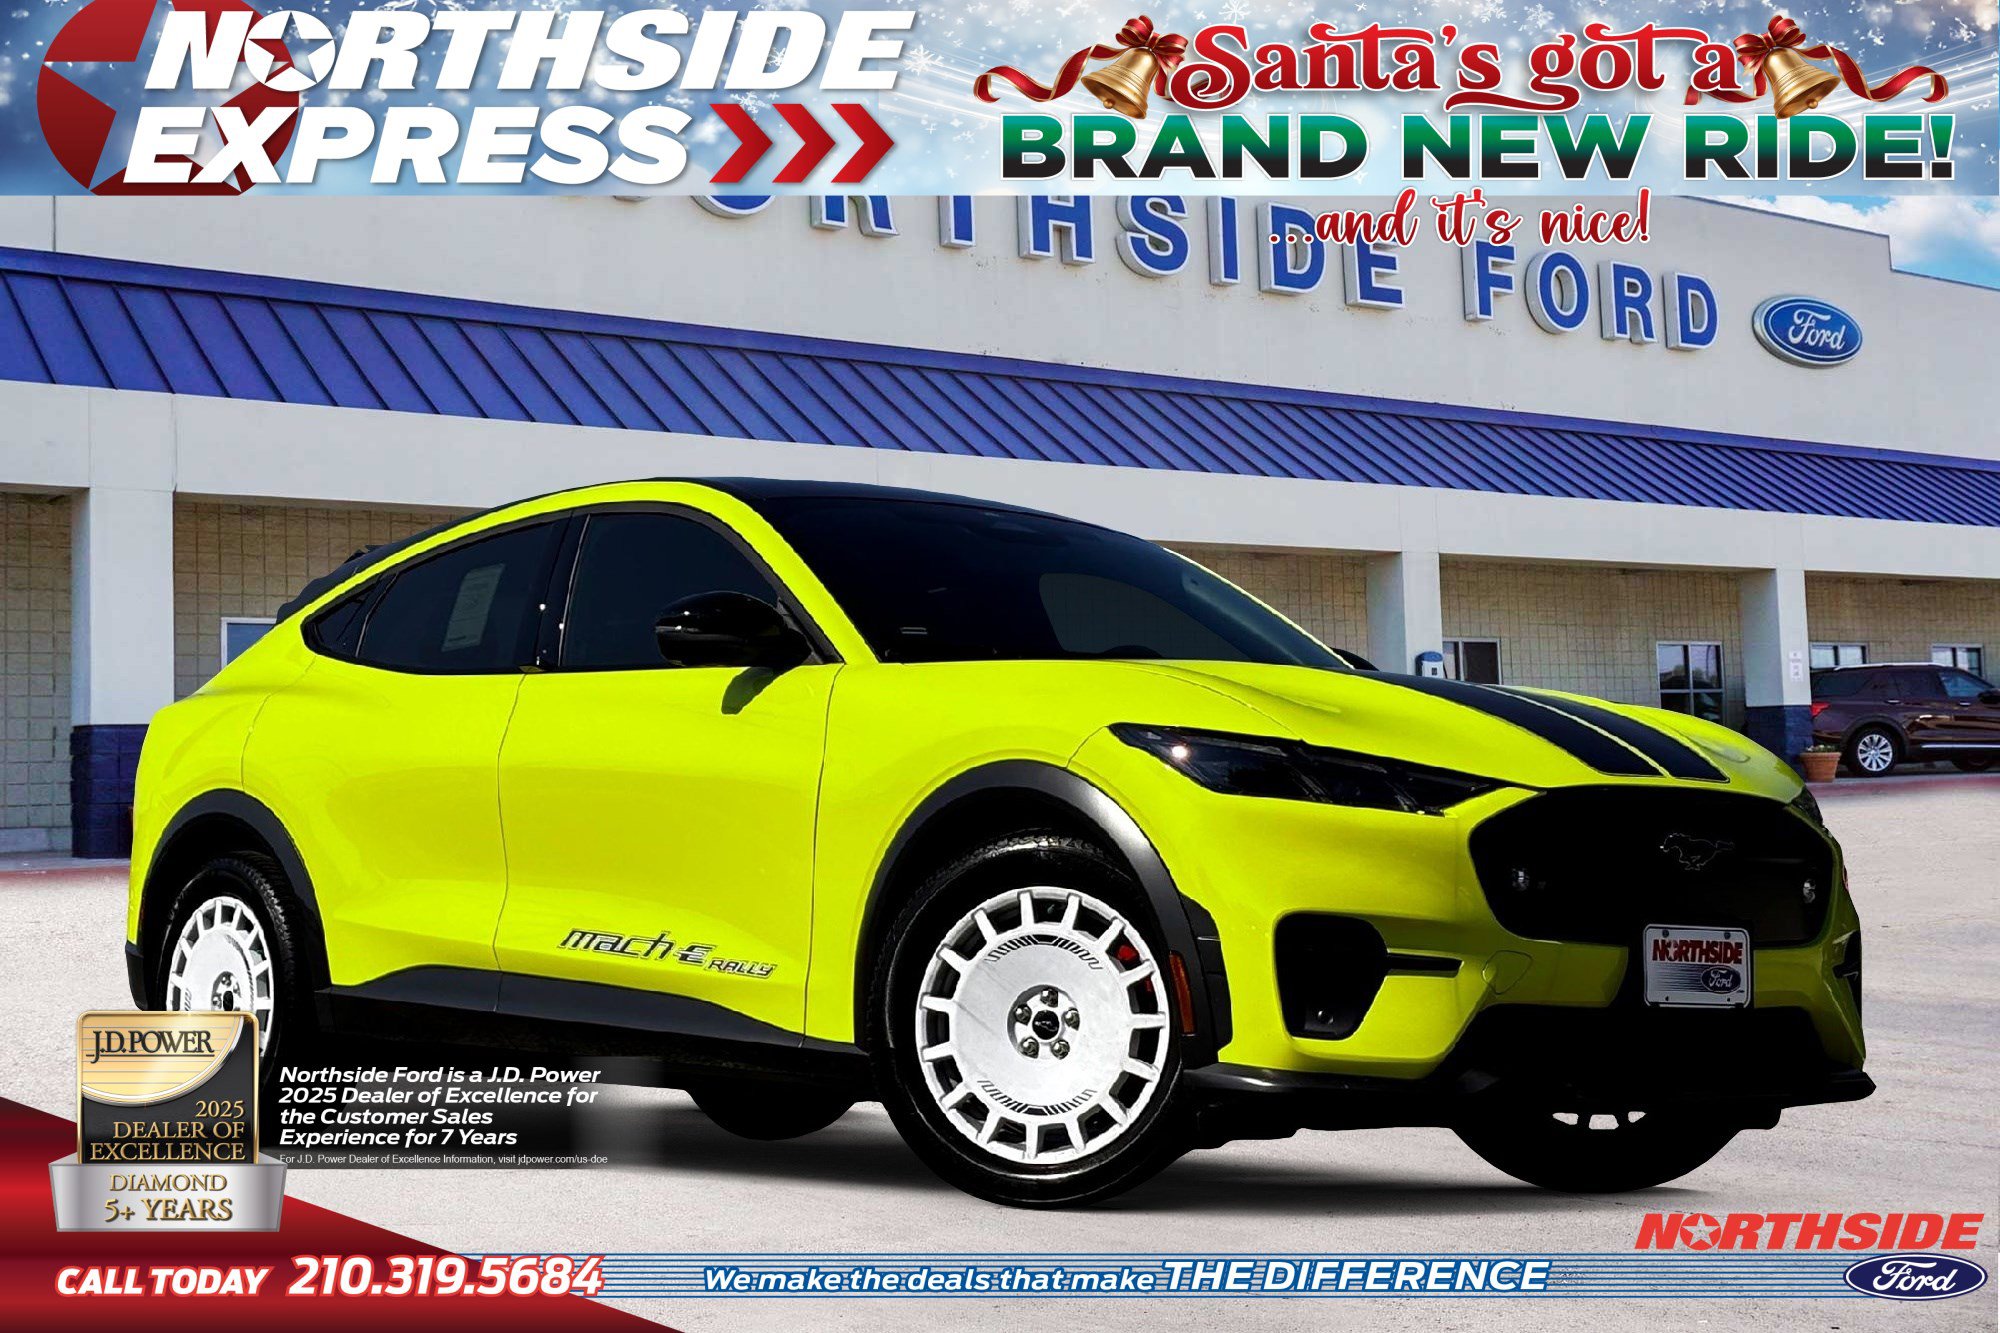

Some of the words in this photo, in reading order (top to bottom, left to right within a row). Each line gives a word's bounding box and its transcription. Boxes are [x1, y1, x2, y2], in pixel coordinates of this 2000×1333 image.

[1464, 239, 1718, 350] FORD
[1787, 310, 1847, 352] Ford
[1652, 939, 1743, 965] NORTHSIDE
[704, 957, 777, 979] RALLY
[1709, 969, 1733, 988] Ford
